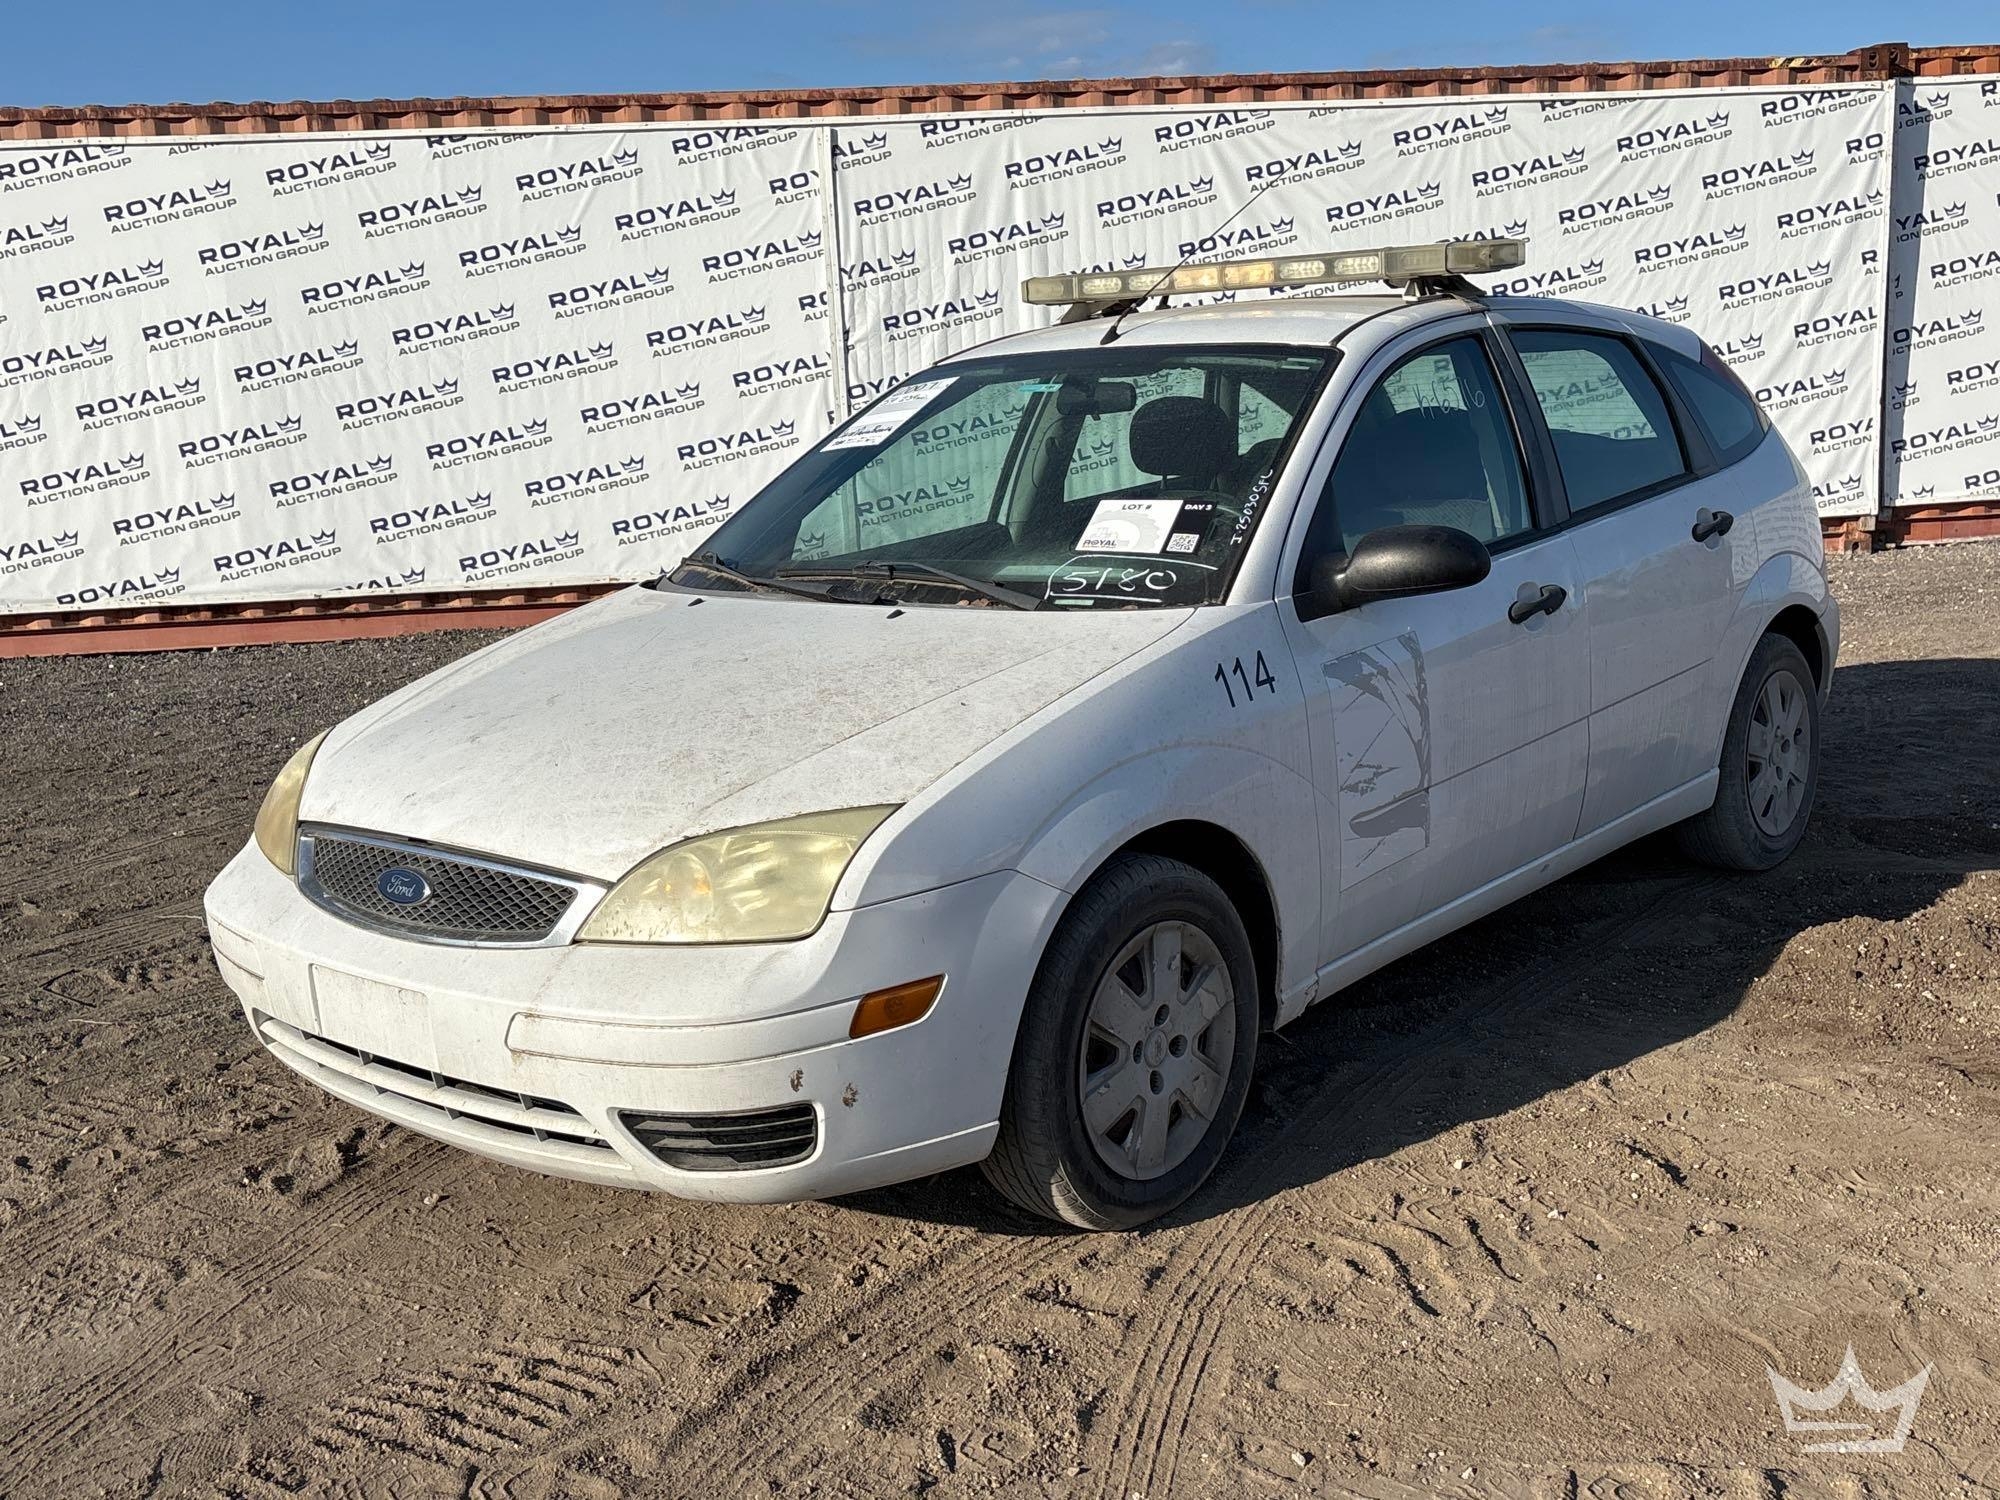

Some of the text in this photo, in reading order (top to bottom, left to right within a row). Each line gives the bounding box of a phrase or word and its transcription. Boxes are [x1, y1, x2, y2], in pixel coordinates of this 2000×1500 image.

[1393, 114, 1485, 146] ROYAL
[1398, 124, 1511, 157] AUCTION GROUP
[1617, 120, 1707, 152] ROYAL
[1621, 130, 1732, 163] AUCTION GROUP
[266, 151, 367, 185] ROYAL
[516, 157, 614, 191] ROYAL
[1005, 146, 1099, 179] ROYAL
[1010, 156, 1126, 190] AUCTION GROUP
[1246, 149, 1339, 181] ROYAL
[1251, 159, 1365, 193] AUCTION GROUP
[1472, 155, 1562, 187] ROYAL
[1702, 158, 1791, 190] ROYAL
[273, 162, 396, 197] AUCTION GROUP
[523, 168, 643, 202] AUCTION GROUP
[1476, 165, 1588, 198] AUCTION GROUP
[1706, 167, 1817, 200] AUCTION GROUP
[103, 188, 206, 222] ROYAL
[112, 199, 237, 233] AUCTION GROUP
[358, 194, 458, 227] ROYAL
[615, 197, 712, 230] ROYAL
[854, 183, 949, 216] ROYAL
[860, 192, 976, 227] AUCTION GROUP
[1097, 185, 1190, 217] ROYAL
[1102, 195, 1217, 229] AUCTION GROUP
[1326, 190, 1417, 222] ROYAL
[1559, 193, 1648, 224] ROYAL
[365, 204, 487, 239] AUCTION GROUP
[622, 208, 740, 242] AUCTION GROUP
[1331, 200, 1444, 233] AUCTION GROUP
[1563, 202, 1673, 235] AUCTION GROUP
[198, 231, 300, 265] ROYAL
[459, 234, 557, 267] ROYAL
[948, 221, 1042, 254] ROYAL
[954, 231, 1068, 265] AUCTION GROUP
[1635, 232, 1723, 264] ROYAL
[206, 241, 329, 276] AUCTION GROUP
[466, 244, 586, 278] AUCTION GROUP
[702, 239, 799, 272] ROYAL
[1639, 241, 1748, 274] AUCTION GROUP
[36, 268, 139, 302] ROYAL
[301, 270, 401, 304] ROYAL
[709, 262, 773, 283] AUCTION
[1719, 269, 1807, 300] ROYAL
[45, 278, 169, 313] AUCTION GROUP
[308, 280, 430, 315] AUCTION GROUP
[548, 275, 646, 308] ROYAL
[555, 285, 674, 319] AUCTION GROUP
[1723, 278, 1833, 311] AUCTION GROUP
[142, 308, 242, 341] ROYAL
[392, 312, 491, 345] ROYAL
[646, 314, 742, 347] ROYAL
[883, 298, 976, 331] ROYAL
[888, 308, 1003, 342] AUCTION GROUP
[150, 318, 272, 353] AUCTION GROUP
[399, 322, 520, 356] AUCTION GROUP
[653, 324, 770, 358] AUCTION GROUP
[234, 349, 334, 382] ROYAL
[241, 358, 363, 393] AUCTION GROUP
[492, 350, 590, 383] ROYAL
[499, 360, 618, 394] AUCTION GROUP
[76, 386, 176, 420] ROYAL
[83, 396, 205, 431] AUCTION GROUP
[336, 387, 435, 420] ROYAL
[343, 396, 464, 431] AUCTION GROUP
[580, 391, 677, 423] ROYAL
[588, 400, 704, 434] AUCTION GROUP
[178, 424, 278, 458] ROYAL
[426, 427, 524, 460] ROYAL
[677, 428, 772, 460] ROYAL
[911, 413, 1003, 446] ROYAL
[917, 424, 1018, 456] AUCTION GROU
[1891, 423, 1977, 454] ROYAL
[186, 433, 307, 469] AUCTION GROUP
[433, 436, 552, 471] AUCTION GROUP
[684, 438, 799, 471] AUCTION GROUP
[1895, 444, 1952, 464] AUCTION
[20, 462, 121, 495] ROYAL
[28, 471, 150, 507] AUCTION GROUP
[269, 464, 369, 497] ROYAL
[276, 473, 397, 508] AUCTION GROUP
[525, 464, 621, 497] ROYAL
[532, 474, 649, 507] AUCTION GROUP
[370, 501, 468, 533] ROYAL
[856, 485, 948, 517] ROYAL
[862, 494, 974, 528] AUCTION GROUP
[113, 502, 212, 535] ROYAL
[120, 511, 241, 546] AUCTION GROUP
[377, 510, 496, 544] AUCTION GROUP
[612, 503, 707, 535] ROYAL
[619, 525, 682, 546] AUCTION
[214, 538, 312, 571] ROYAL
[221, 547, 341, 582] AUCTION GROUP
[459, 539, 556, 572] ROYAL
[466, 548, 584, 583] AUCTION GROUP
[1062, 568, 1177, 591] 5180
[1214, 650, 1275, 708] 114
[387, 874, 416, 897] Ford
